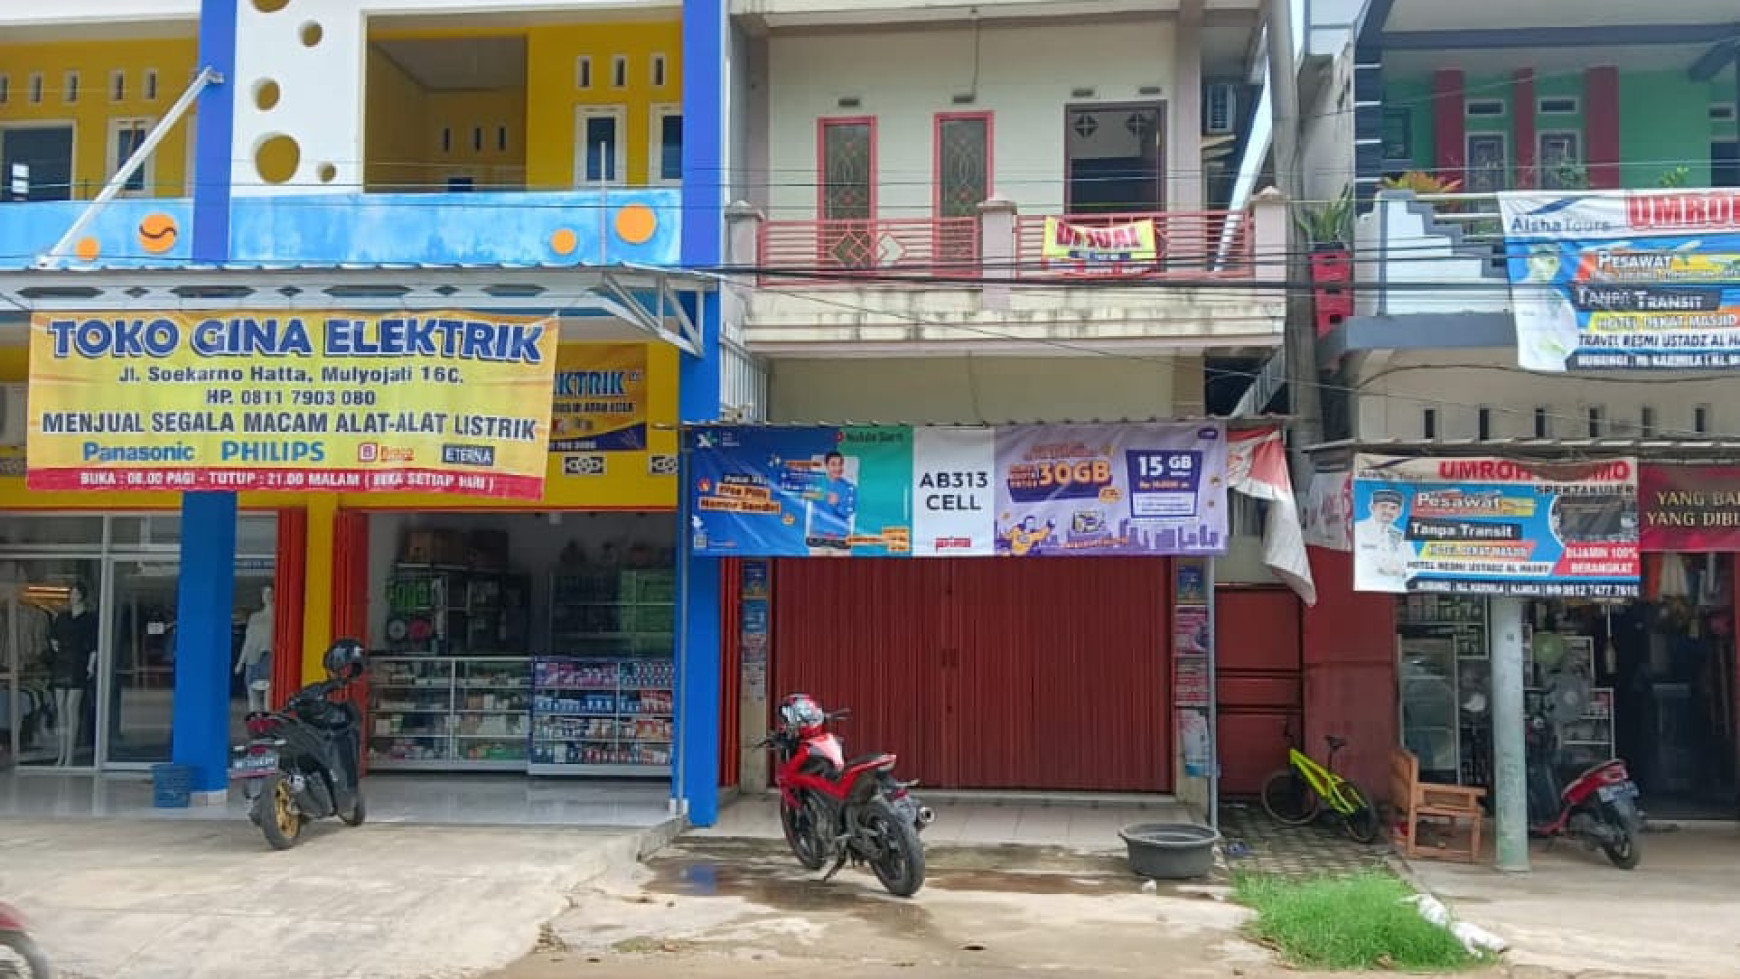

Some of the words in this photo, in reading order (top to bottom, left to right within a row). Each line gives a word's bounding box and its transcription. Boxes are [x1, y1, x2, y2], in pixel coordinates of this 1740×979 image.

[1633, 290, 1704, 308] TRANSIT
[47, 318, 181, 358] TOKO
[191, 318, 314, 357] GINA
[324, 317, 544, 362] ELEKTRIK
[119, 366, 140, 382] Jl.
[148, 366, 243, 382] Soekarno
[321, 366, 413, 385] Mulyojati
[206, 390, 233, 405] HP.
[241, 390, 283, 405] 0811
[292, 390, 336, 405] 7903
[341, 390, 376, 405] 080
[43, 412, 145, 433] MENJUAL
[151, 412, 235, 433] SEGALA
[243, 412, 328, 433] MACAM
[335, 411, 448, 433] ALAT-ALAT
[454, 415, 536, 440] LISTRIK
[82, 441, 196, 462] Panasonic
[221, 441, 326, 462] PHILIPS
[444, 447, 492, 465] ETERNA
[1037, 461, 1111, 486] 30GB
[1138, 455, 1163, 476] 15
[1168, 455, 1192, 469] GB
[165, 472, 196, 486] PAGI
[208, 472, 256, 486] TUTUP
[268, 473, 304, 486] 21.00
[308, 473, 359, 487] MALAM
[919, 472, 989, 489] AB313
[926, 493, 983, 511] CELL
[1418, 490, 1500, 507] Pesawat
[1657, 490, 1705, 506] YANG
[1647, 512, 1696, 527] YANG
[1411, 523, 1456, 538] Tanpa
[1461, 524, 1513, 537] Transit
